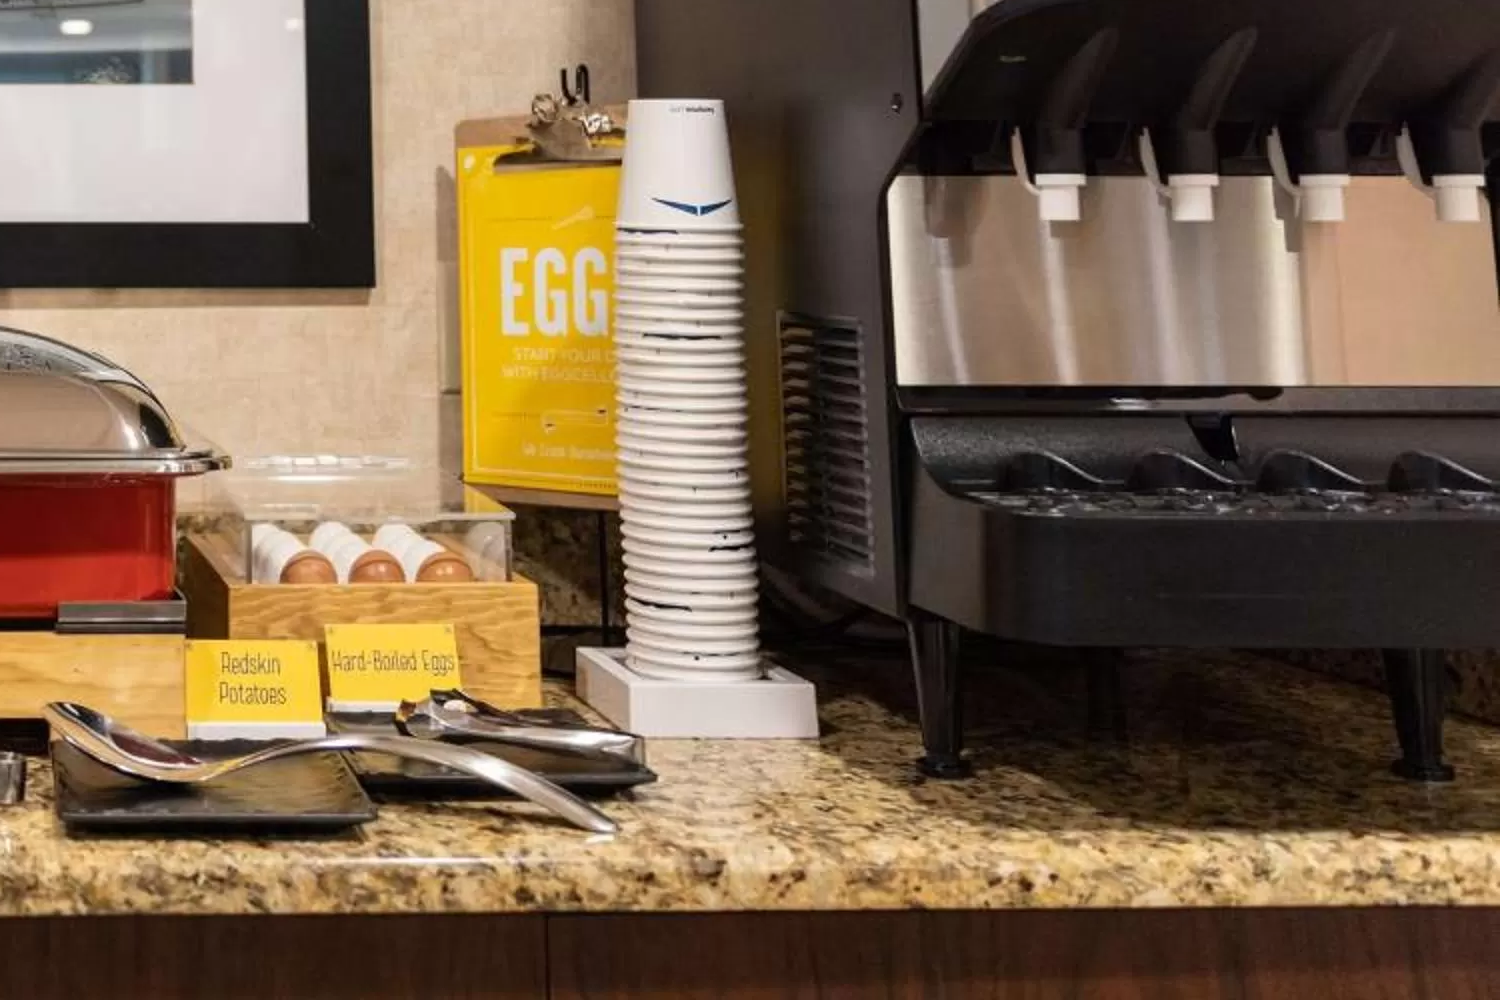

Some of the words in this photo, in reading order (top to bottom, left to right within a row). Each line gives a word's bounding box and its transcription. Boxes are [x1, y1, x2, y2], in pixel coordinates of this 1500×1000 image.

[499, 247, 613, 337] EGG
[221, 651, 281, 676] Redskin
[332, 650, 418, 673] Hard-Boiled
[422, 650, 455, 676] Eggs
[219, 681, 287, 705] Potatoes
